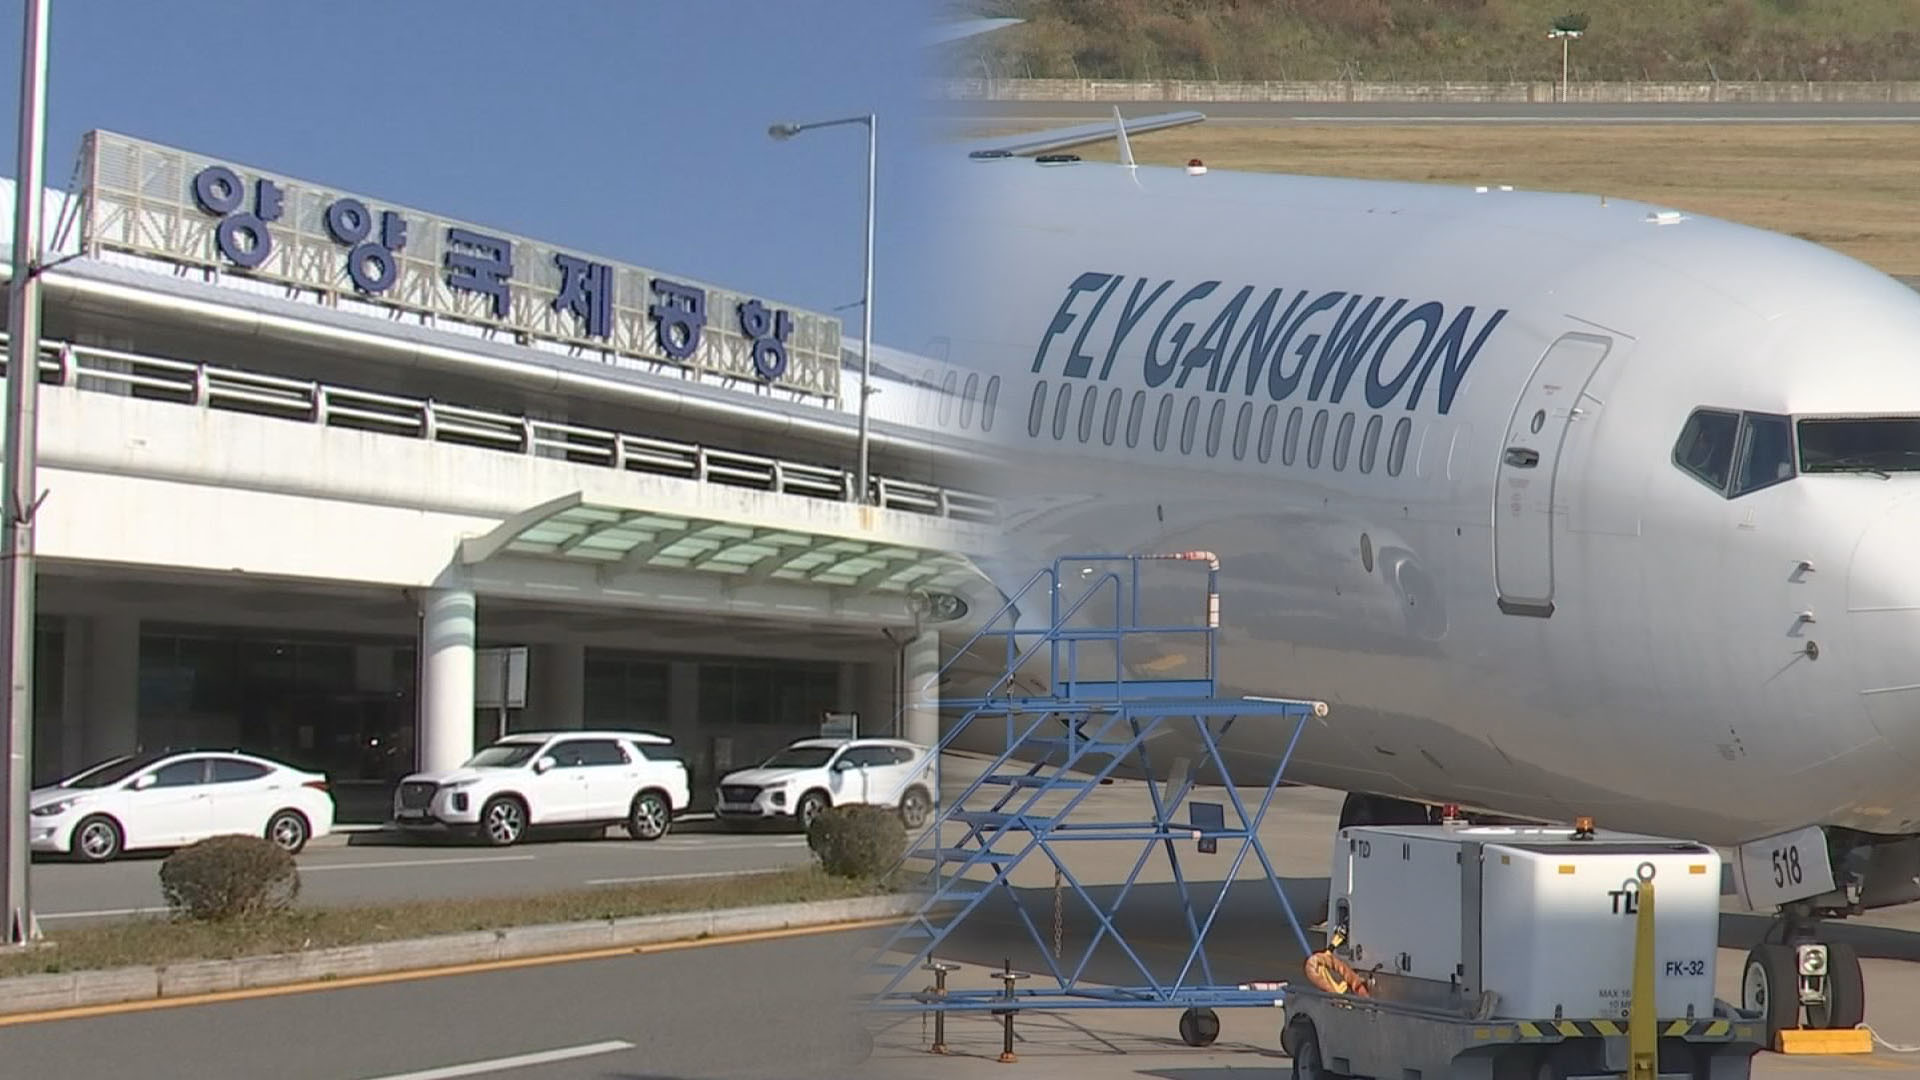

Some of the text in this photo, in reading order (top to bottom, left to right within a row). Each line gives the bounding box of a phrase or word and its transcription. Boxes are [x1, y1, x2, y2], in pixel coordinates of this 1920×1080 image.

[1031, 271, 1508, 415] FLY GANGWON
[1772, 845, 1802, 889] 518
[1608, 890, 1640, 915] TL
[1666, 961, 1704, 976] FK-32
